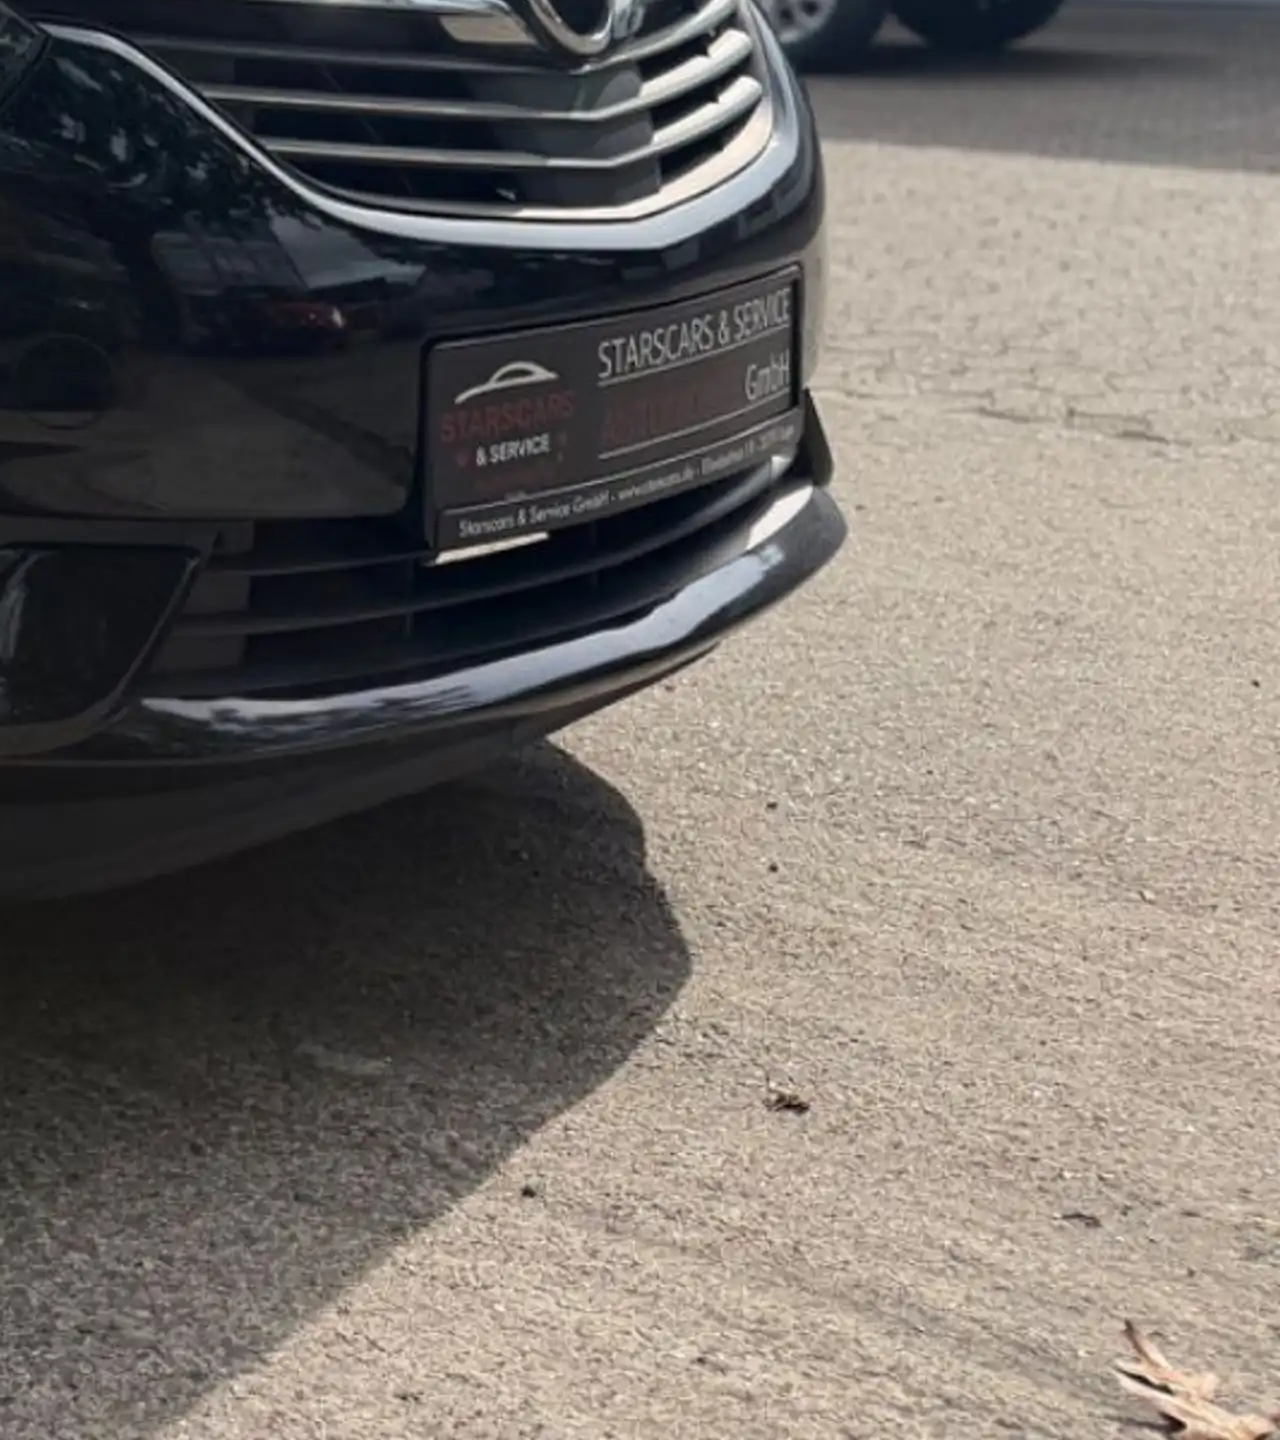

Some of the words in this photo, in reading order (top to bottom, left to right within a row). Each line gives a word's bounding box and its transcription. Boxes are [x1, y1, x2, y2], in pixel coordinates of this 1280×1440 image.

[598, 314, 714, 379] STARSCARS
[718, 309, 730, 346] &
[733, 288, 790, 341] SERVICE
[744, 348, 790, 401] GmbH
[440, 390, 575, 443] STARSCARS
[475, 441, 488, 468] &
[488, 431, 552, 466] SERVICE
[458, 514, 515, 539] Starscars
[528, 504, 570, 525] Service
